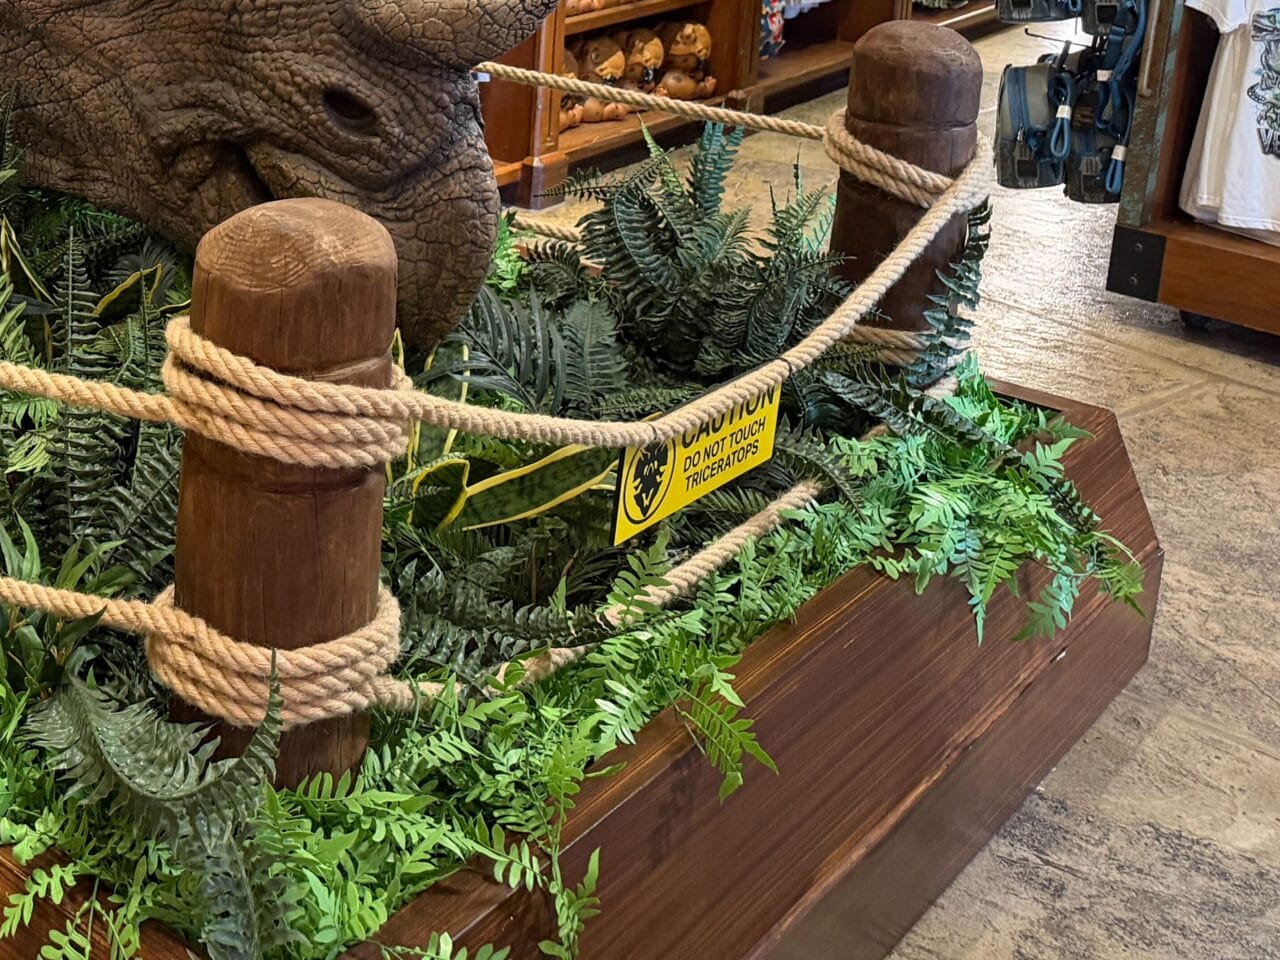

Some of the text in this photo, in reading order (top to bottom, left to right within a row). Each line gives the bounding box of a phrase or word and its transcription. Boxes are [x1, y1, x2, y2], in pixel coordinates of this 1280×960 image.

[684, 416, 766, 473] DO NOT TOUCH
[685, 439, 759, 492] TRICERATOPS
